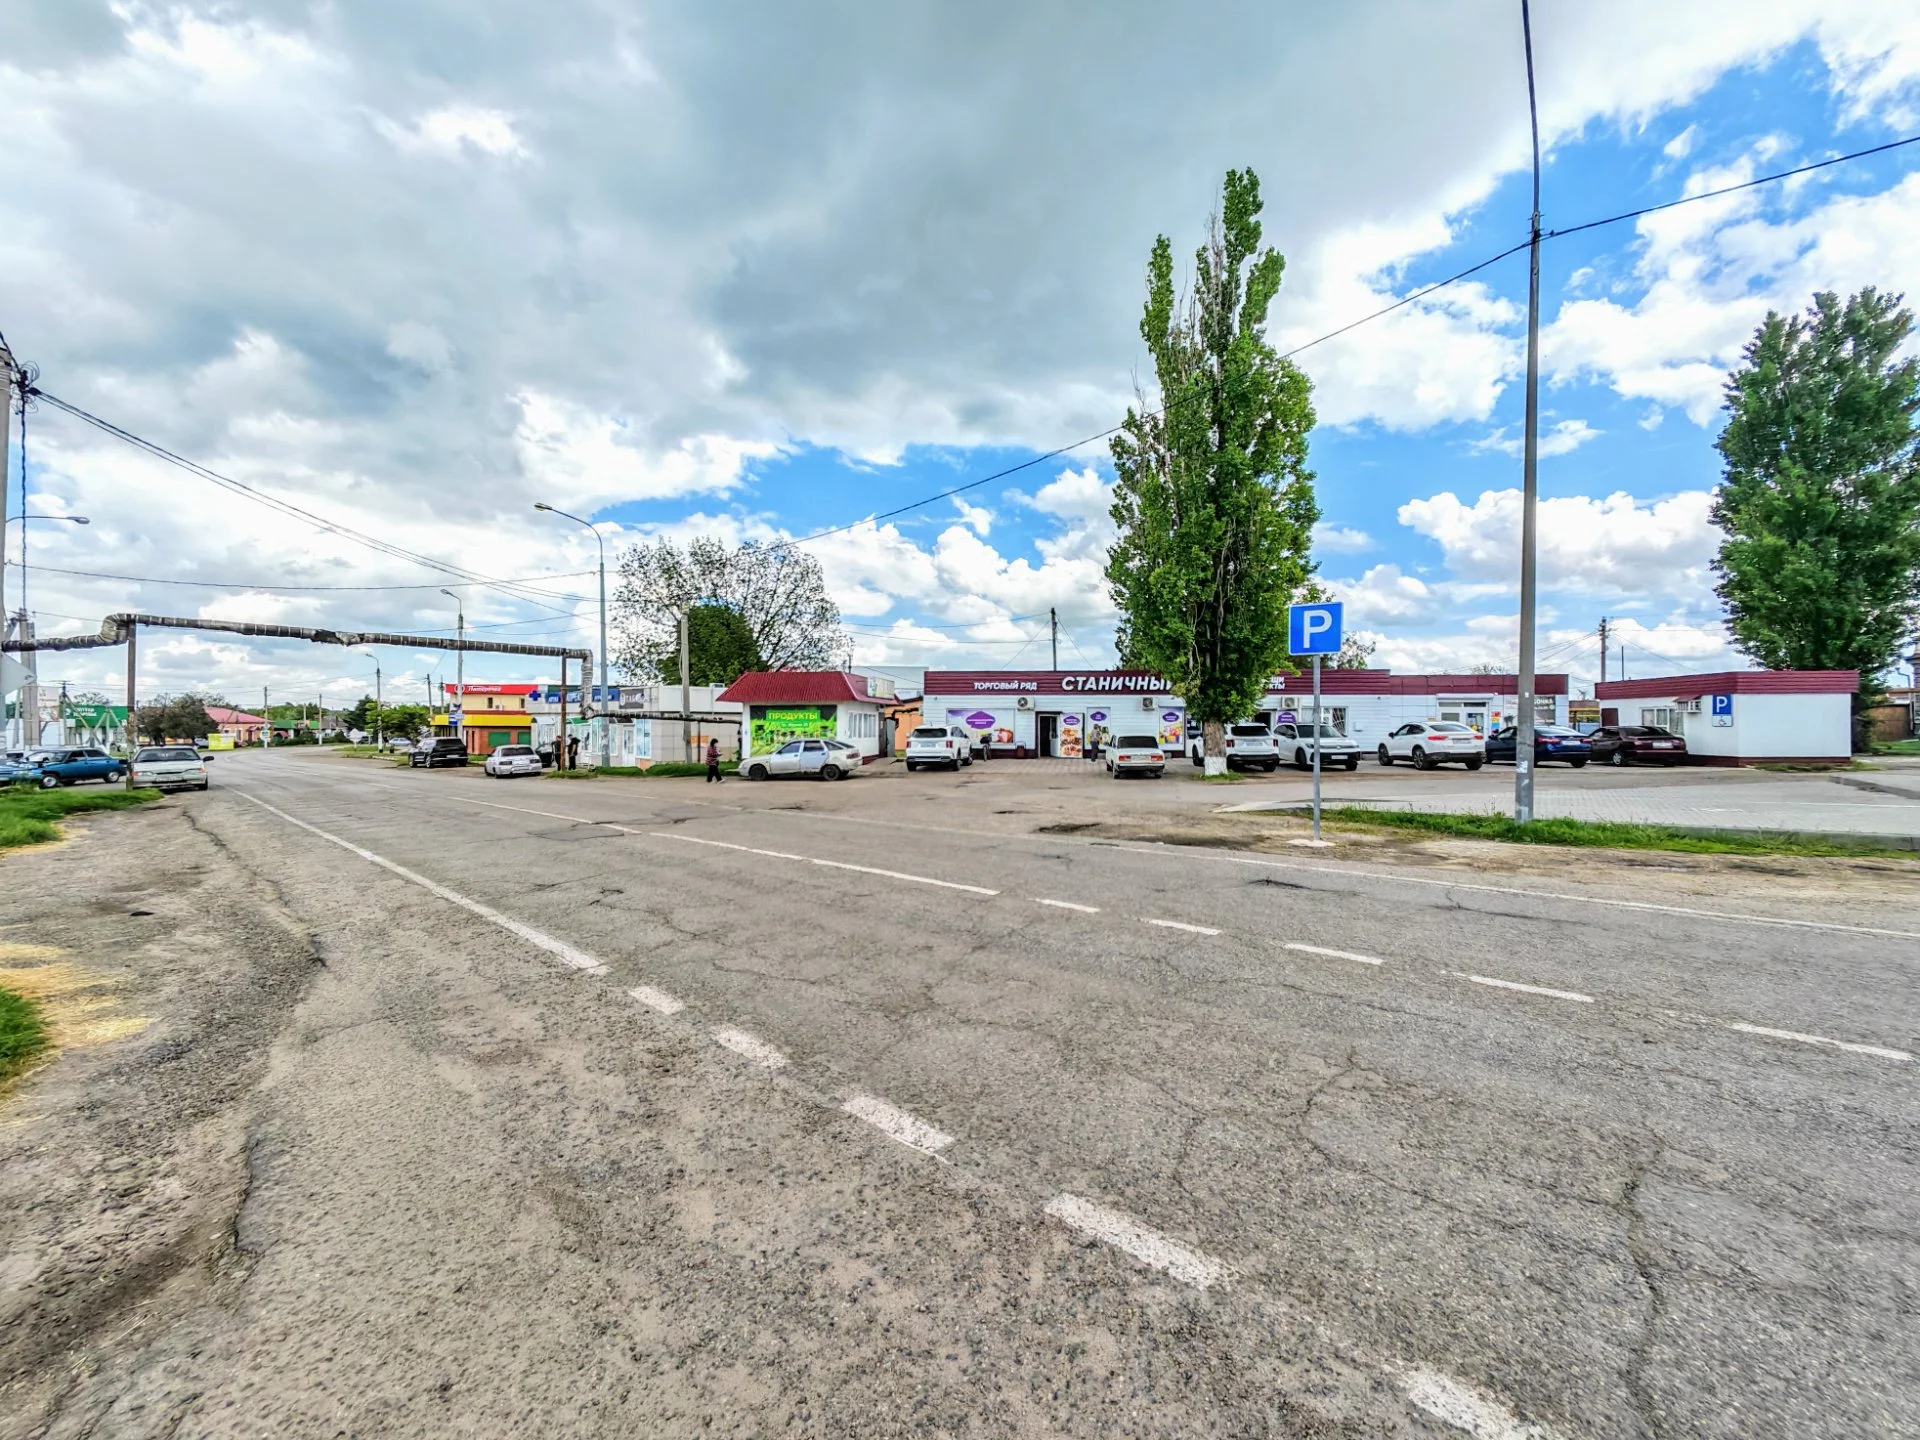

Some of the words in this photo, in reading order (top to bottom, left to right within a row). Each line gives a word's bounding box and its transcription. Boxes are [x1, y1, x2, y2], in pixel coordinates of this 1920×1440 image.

[1303, 610, 1333, 649] P
[974, 680, 1019, 690] ТОРГОВЫЙ
[1020, 682, 1038, 691] РЯД
[1716, 696, 1728, 713] P
[768, 712, 818, 720] ПРОДУКТЫ
